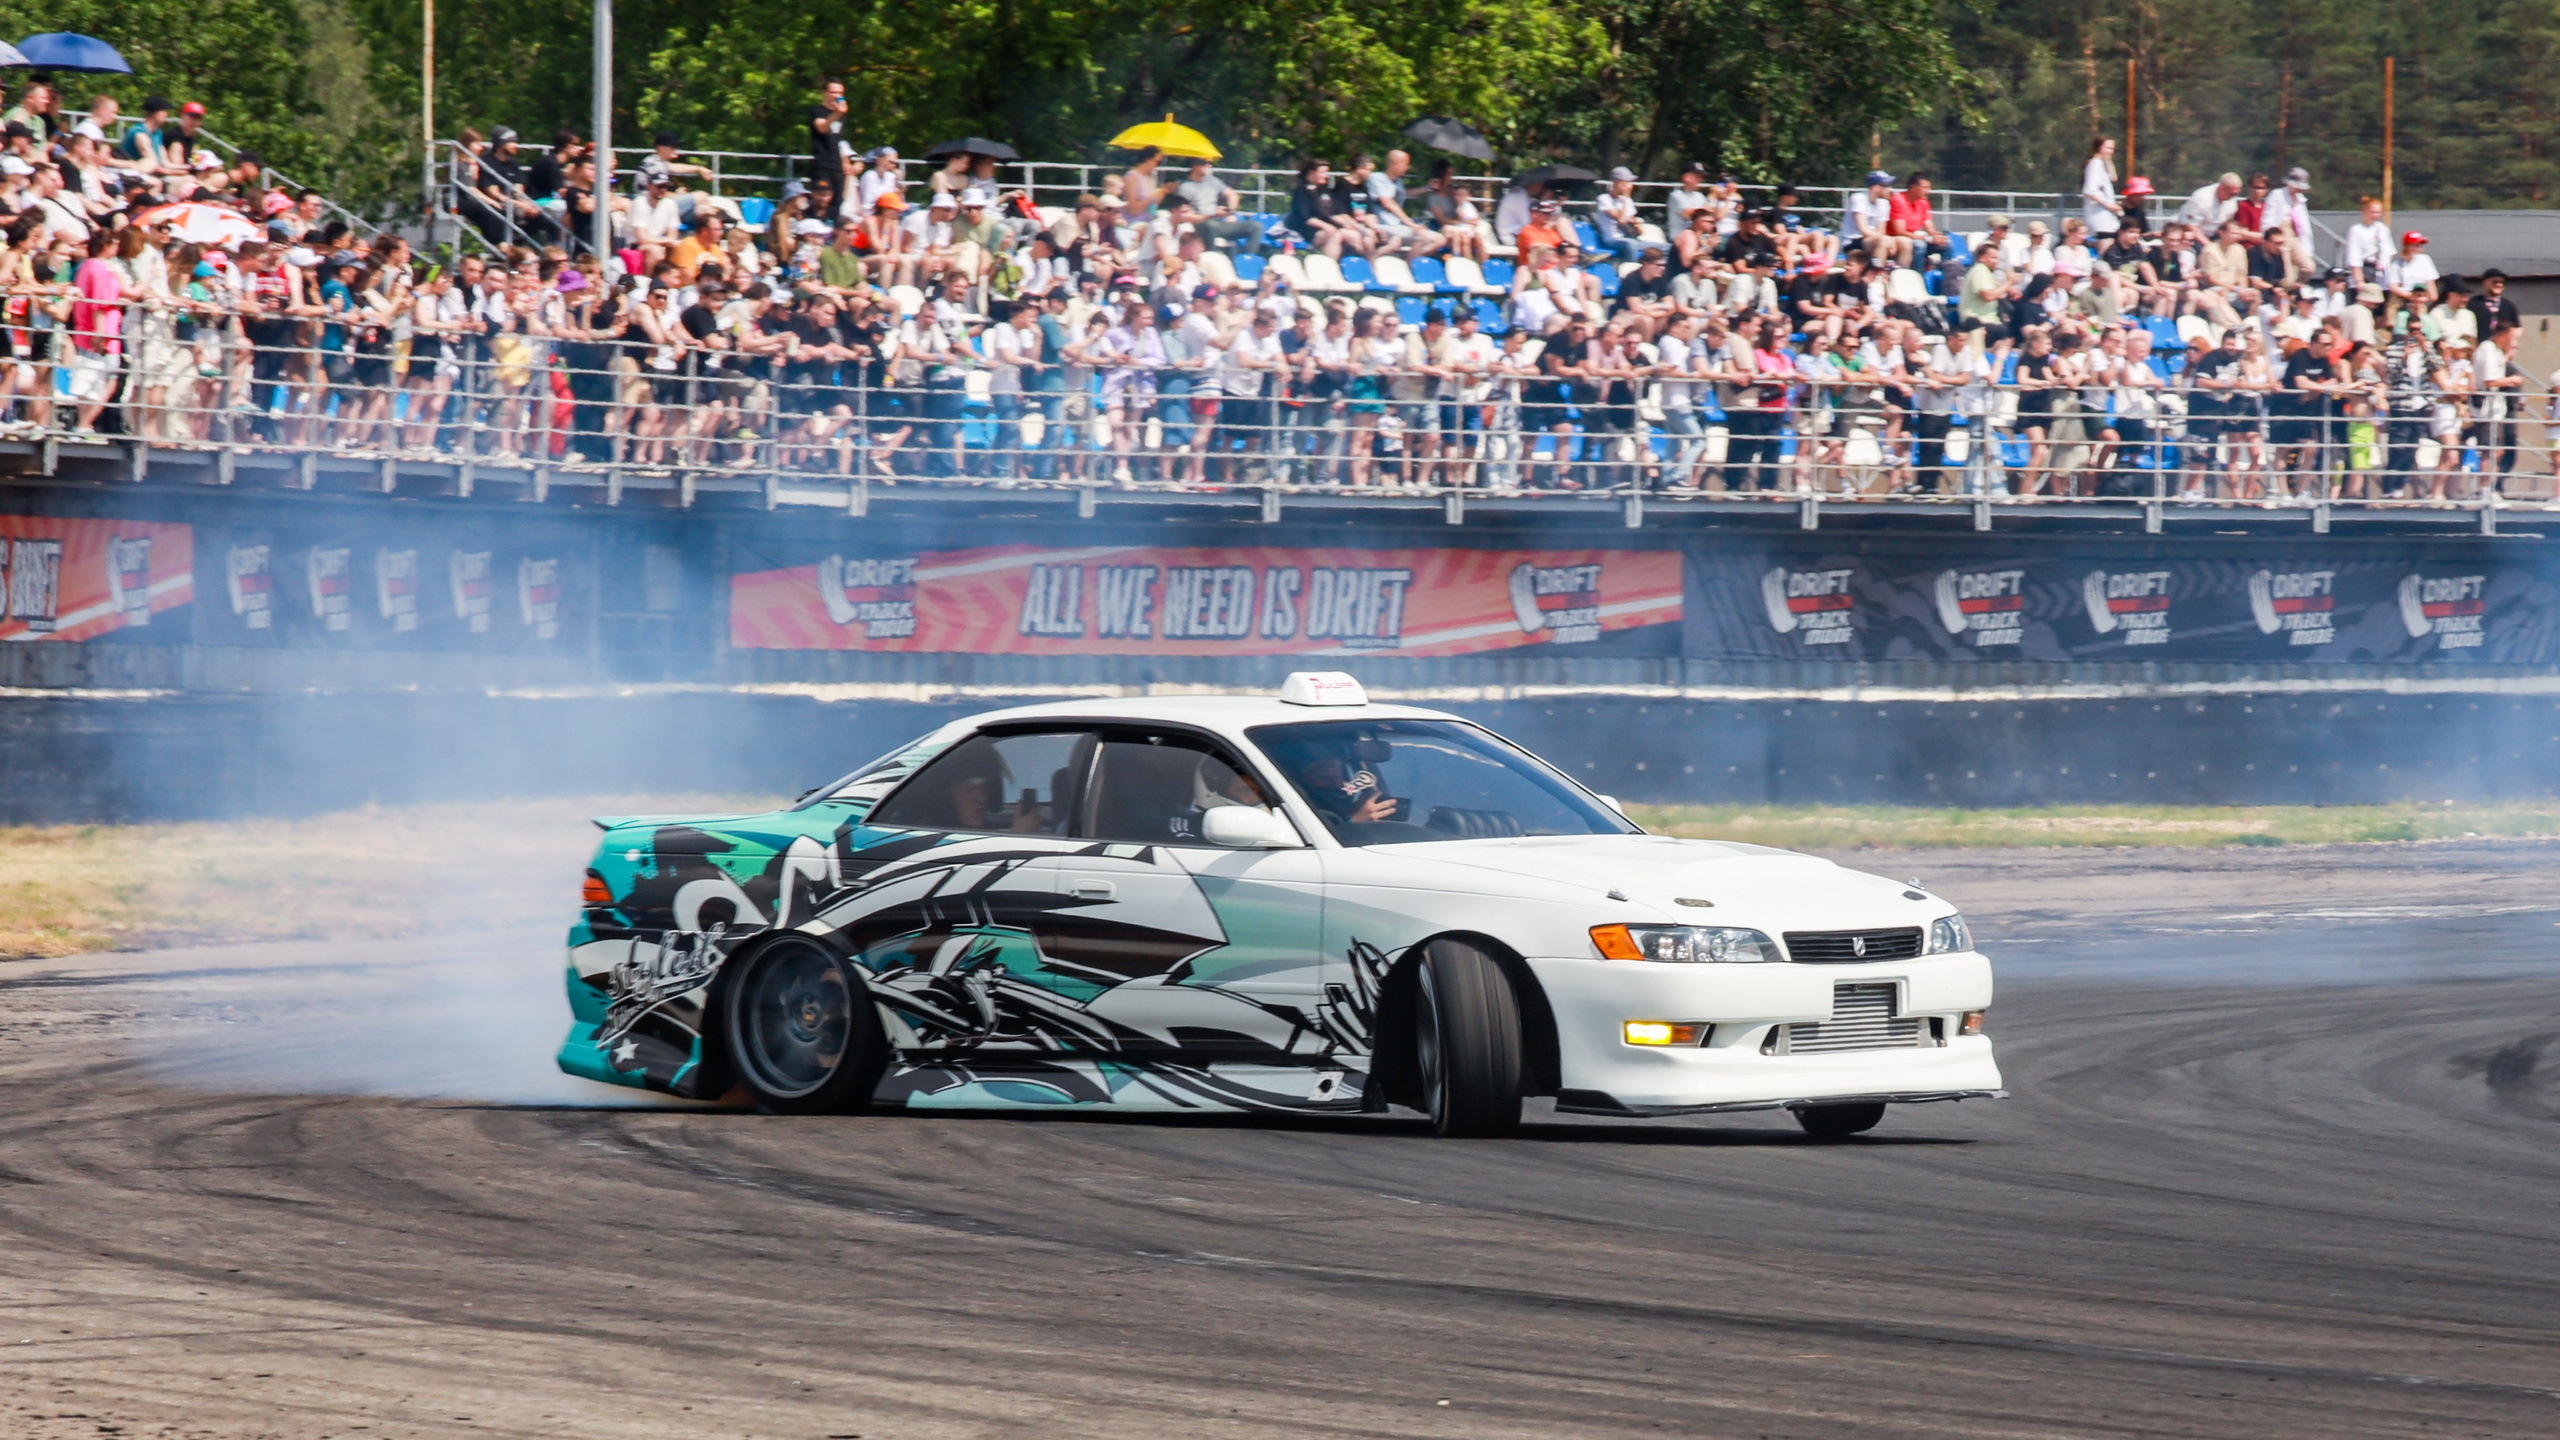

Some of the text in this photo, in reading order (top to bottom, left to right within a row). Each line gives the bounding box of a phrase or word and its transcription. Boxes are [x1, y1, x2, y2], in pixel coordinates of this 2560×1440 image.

[845, 558, 919, 586] DRIFT
[1536, 564, 1602, 594] DRIFT
[1787, 569, 1854, 597] DRIFT
[1958, 571, 2025, 598] DRIFT
[2107, 571, 2171, 598] DRIFT
[2272, 571, 2336, 598] DRIFT
[1018, 564, 1412, 638] ALL WE NEED IS DRIFT
[2422, 575, 2486, 602] DRIFT
